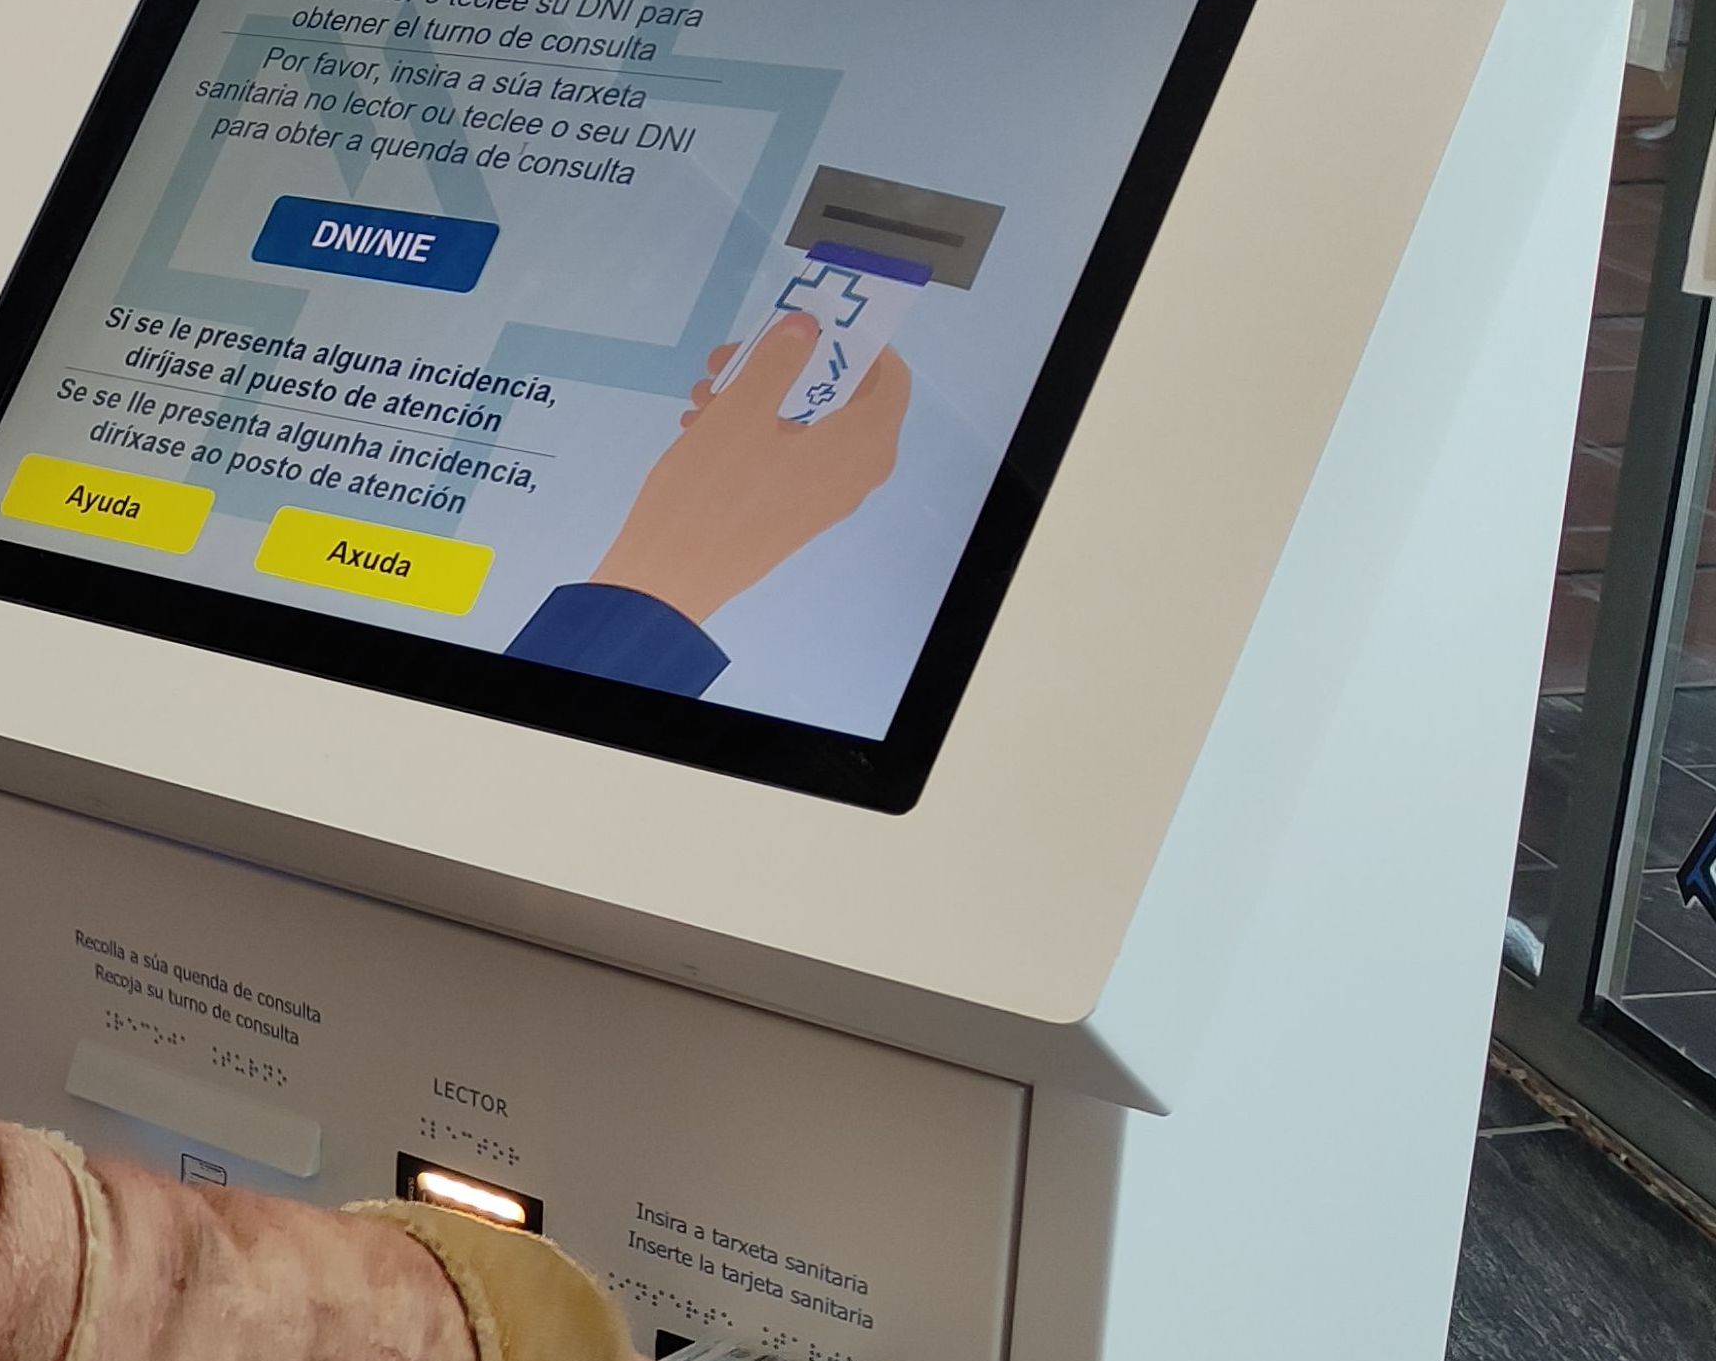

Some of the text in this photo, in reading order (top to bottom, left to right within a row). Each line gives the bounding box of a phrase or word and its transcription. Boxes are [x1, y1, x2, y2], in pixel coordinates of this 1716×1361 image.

[292, 6, 658, 62] obtener el turno de consulta
[636, 3, 704, 28] para
[262, 47, 646, 109] Por favor, insira a súa tarxeta
[195, 79, 697, 153] sanitaria no lector ou teclee o seu DNI
[211, 114, 637, 185] para obter a quenda de consulta
[311, 218, 436, 263] DNI/NIE
[105, 306, 558, 408] Si se le presenta alguna incidencia,
[125, 345, 503, 433] diríjase al puesto de atención
[57, 378, 538, 493] Se se lle presenta algunha incidencia,
[89, 419, 467, 515] diríxase ao posto de atención
[65, 484, 142, 520] Ayuda
[326, 540, 413, 579] Axuda
[75, 929, 322, 1024] Recolla a súa quenda de consulta
[95, 963, 300, 1046] Recoja su turno de consulta
[433, 1077, 509, 1118] LECTOR
[628, 1230, 875, 1330] Inserte la tarjeta sanitaria
[636, 1201, 870, 1295] Insira a tarxeta sanitaria
